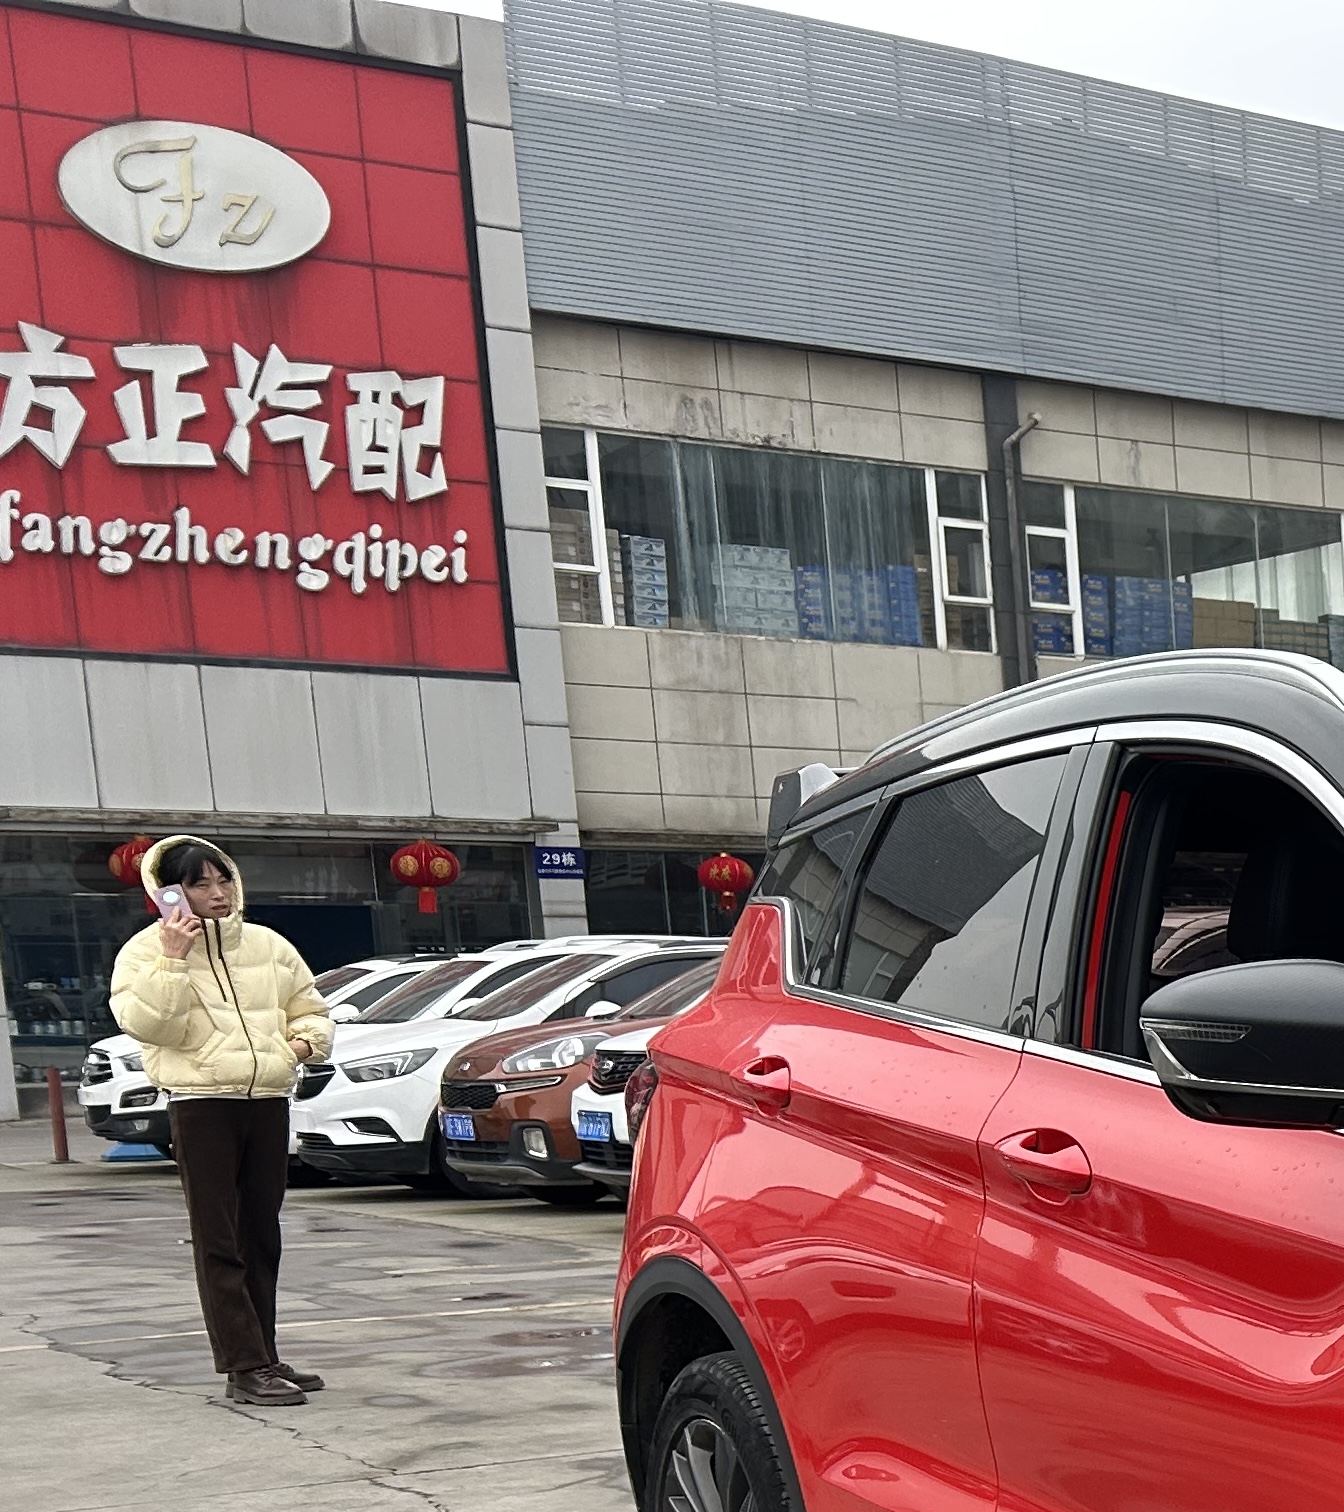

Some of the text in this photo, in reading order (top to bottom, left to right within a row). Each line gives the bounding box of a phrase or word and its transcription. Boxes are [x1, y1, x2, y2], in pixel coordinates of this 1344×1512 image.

[0, 321, 448, 502] 方正汽配
[0, 489, 469, 595] fangzhengqipei
[542, 851, 576, 867] 29栋
